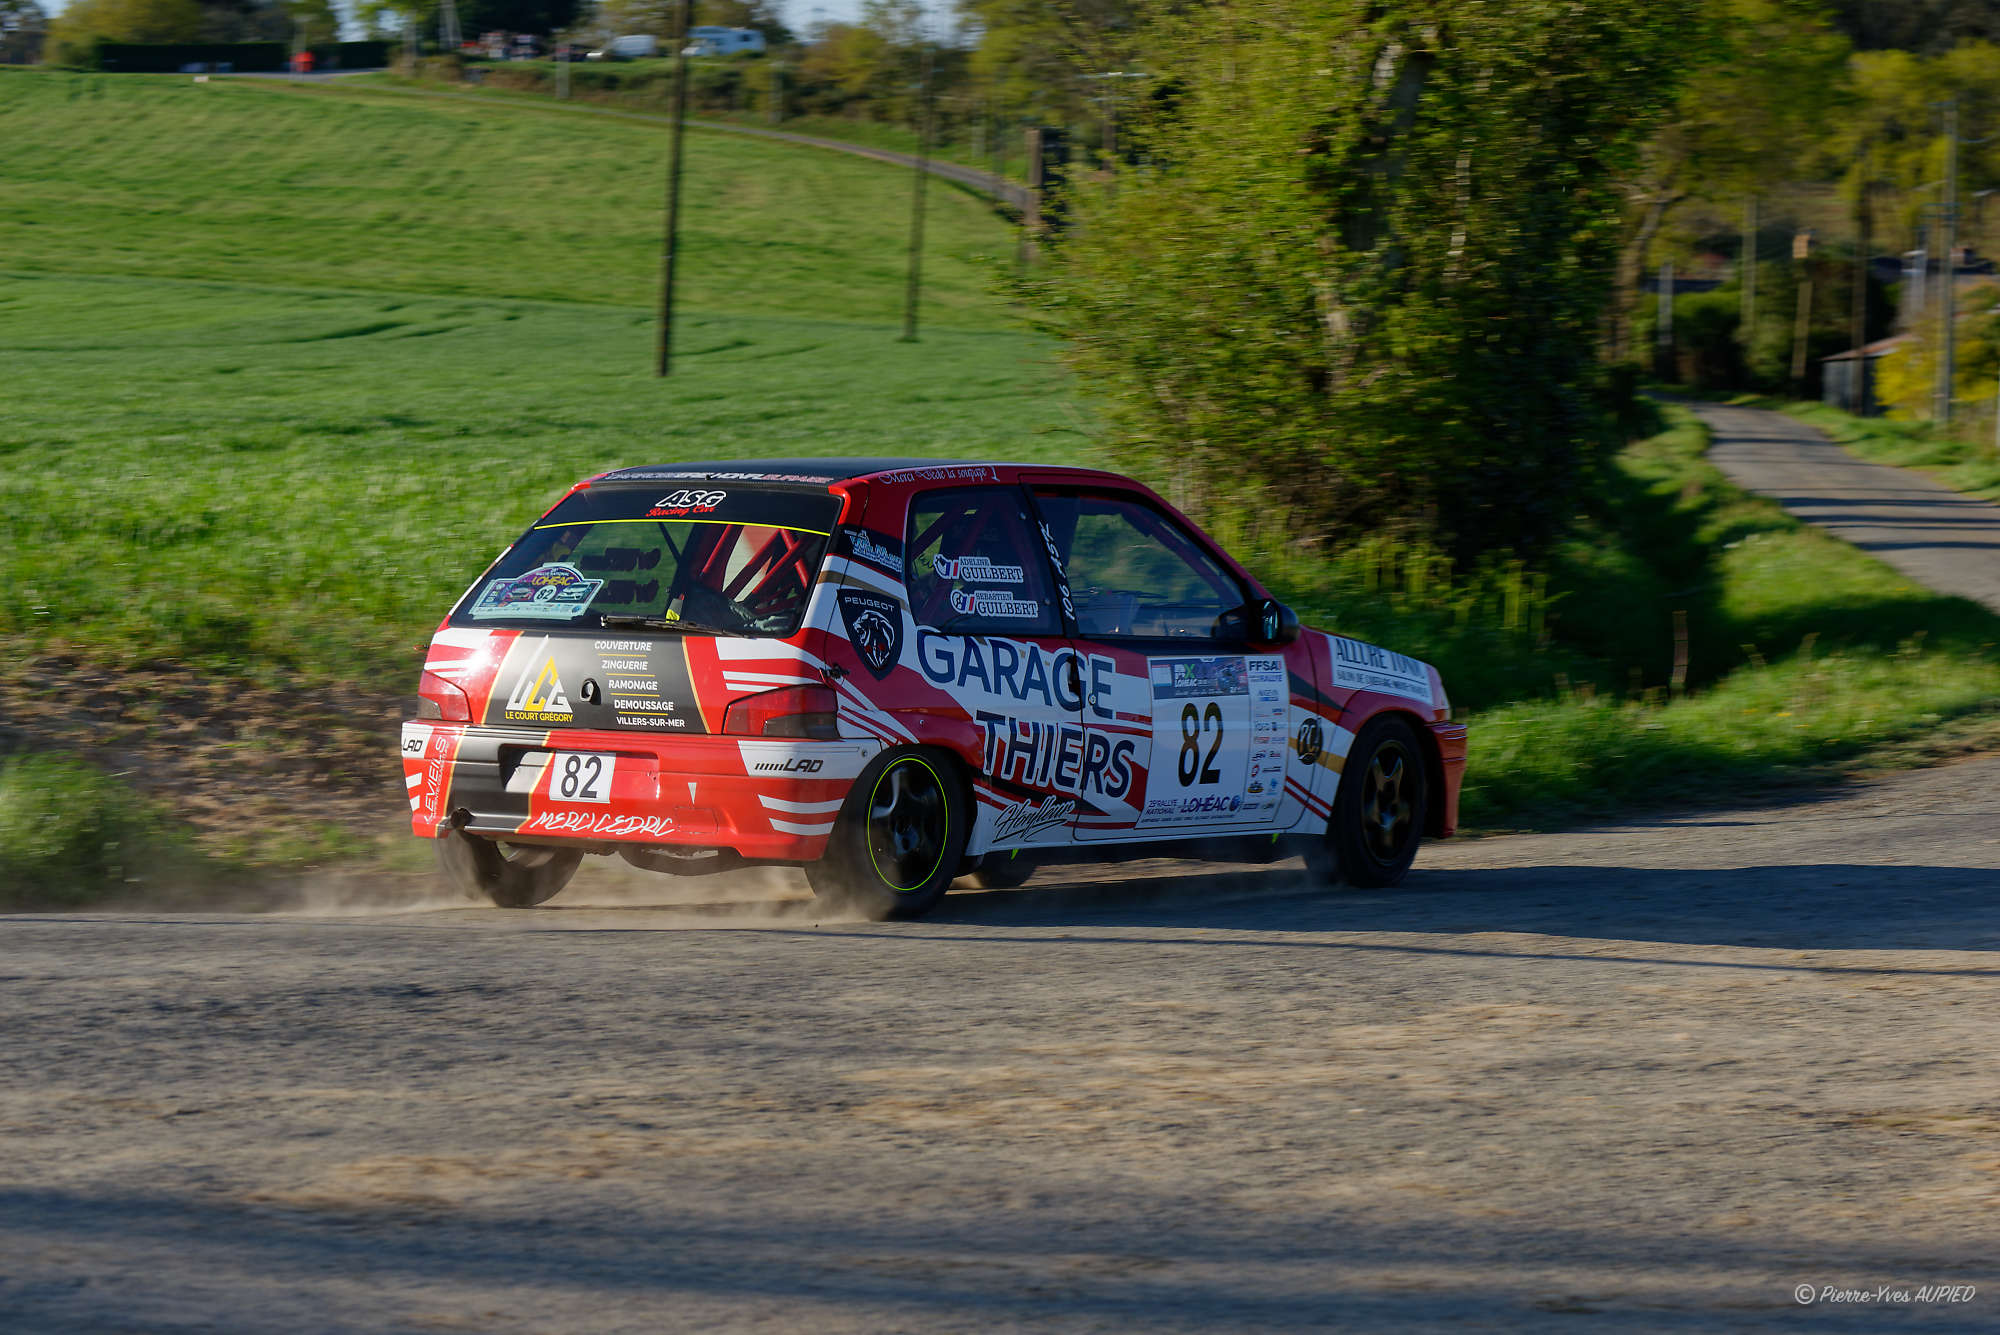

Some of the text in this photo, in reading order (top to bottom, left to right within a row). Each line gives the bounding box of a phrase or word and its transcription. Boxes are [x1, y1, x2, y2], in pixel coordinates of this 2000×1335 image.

[655, 490, 726, 507] ASG
[645, 505, 715, 517] Racing Car
[962, 566, 1023, 580] GUILBERT
[536, 588, 554, 600] 82
[845, 597, 894, 611] PEUGEOT
[977, 601, 1037, 616] GUILBERT
[1059, 583, 1076, 621] 106
[594, 640, 652, 651] COUVERTURE
[1336, 638, 1388, 669] ALLURE
[601, 660, 648, 671] ZINGUERIE
[1249, 660, 1280, 672] FFSA
[917, 629, 1115, 720] GARAGE
[608, 679, 658, 690] RAMONAGE
[614, 699, 674, 711] DEMOUSSAGE
[505, 711, 573, 722] LE COURT GRÉGORY
[616, 716, 685, 728] VILLERS-SUR-MER
[403, 738, 423, 752] LAD
[1178, 702, 1224, 788] 82
[976, 709, 1136, 798] THIERS
[783, 758, 824, 773] LAD
[560, 755, 602, 799] 82
[1180, 794, 1230, 813] LOHÉAC
[530, 812, 676, 836] MERCI CEDRIC
